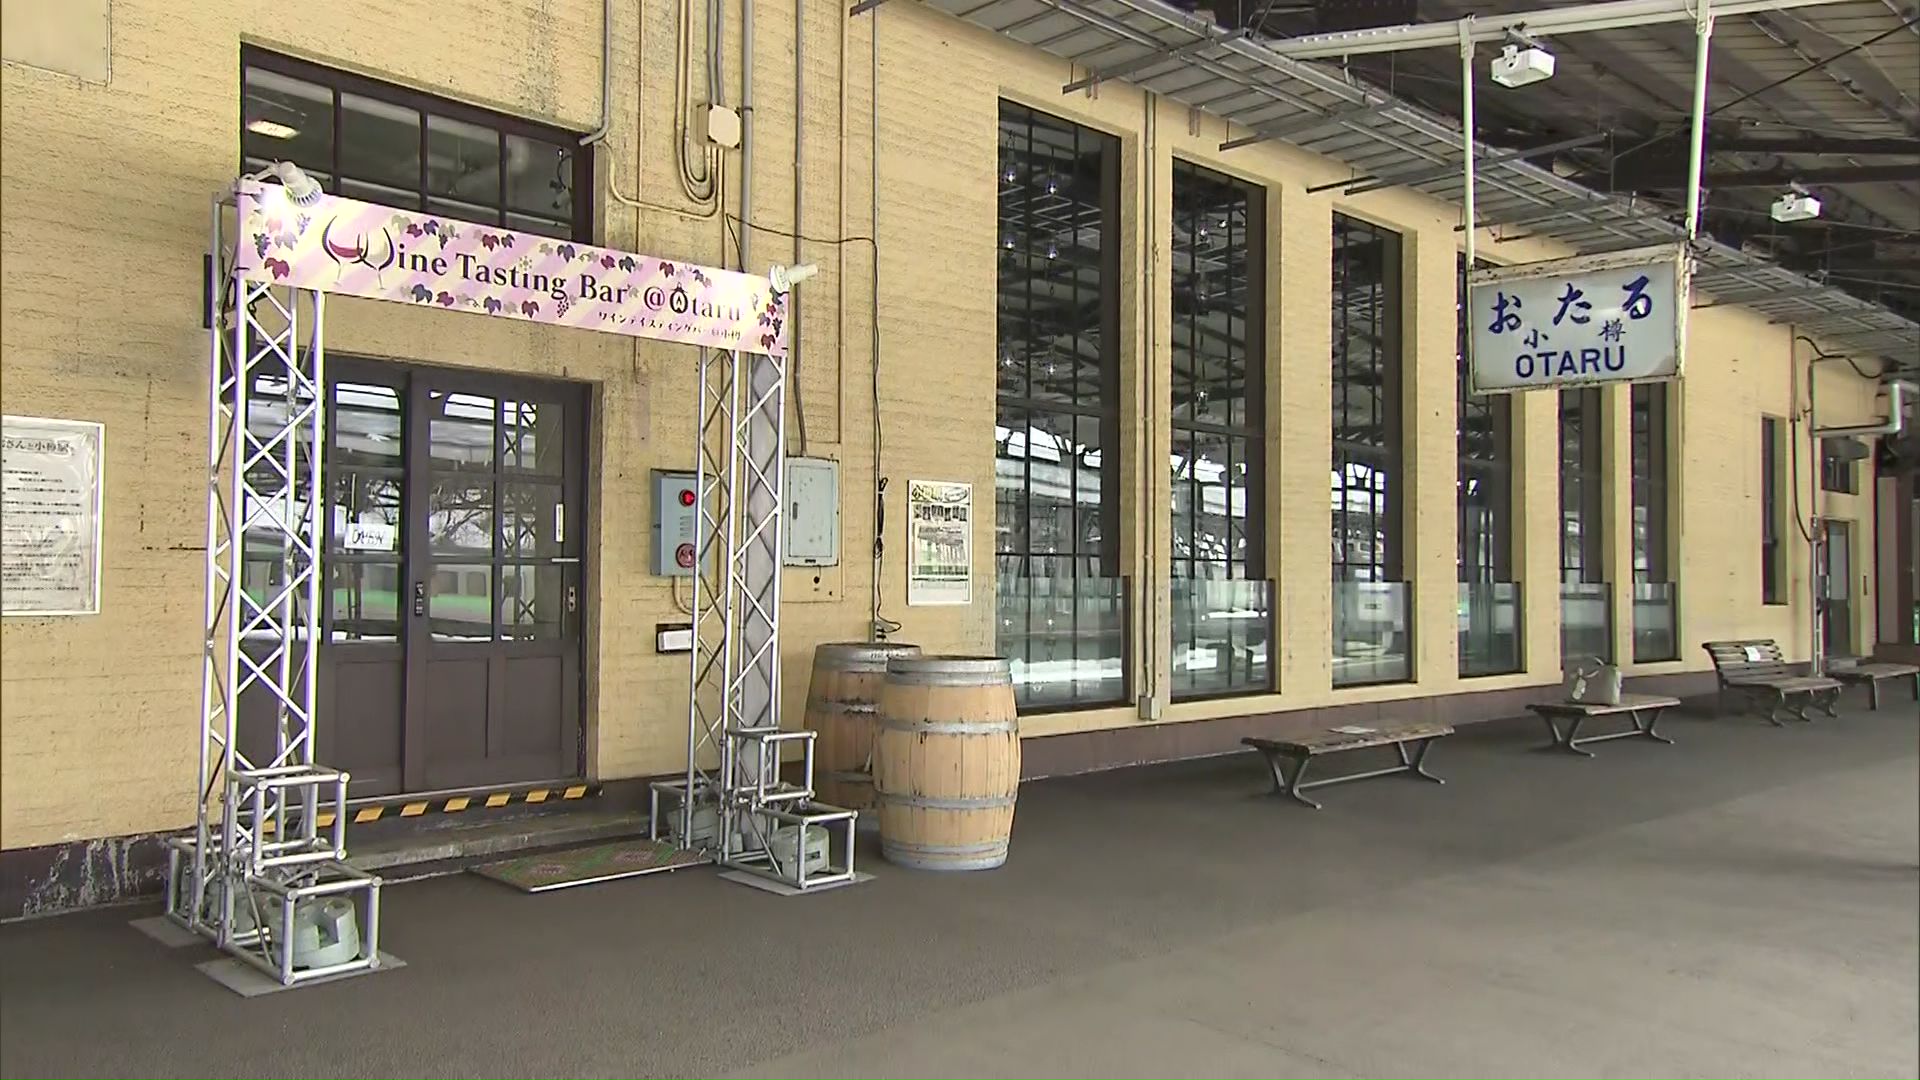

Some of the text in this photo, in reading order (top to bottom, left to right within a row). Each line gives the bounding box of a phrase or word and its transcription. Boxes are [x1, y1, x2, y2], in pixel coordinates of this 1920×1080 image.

[456, 252, 568, 301] Tasting
[579, 273, 628, 304] Bar
[1488, 275, 1653, 334] おたる
[1523, 318, 1626, 350] 小樽
[1516, 345, 1626, 379] OTARU
